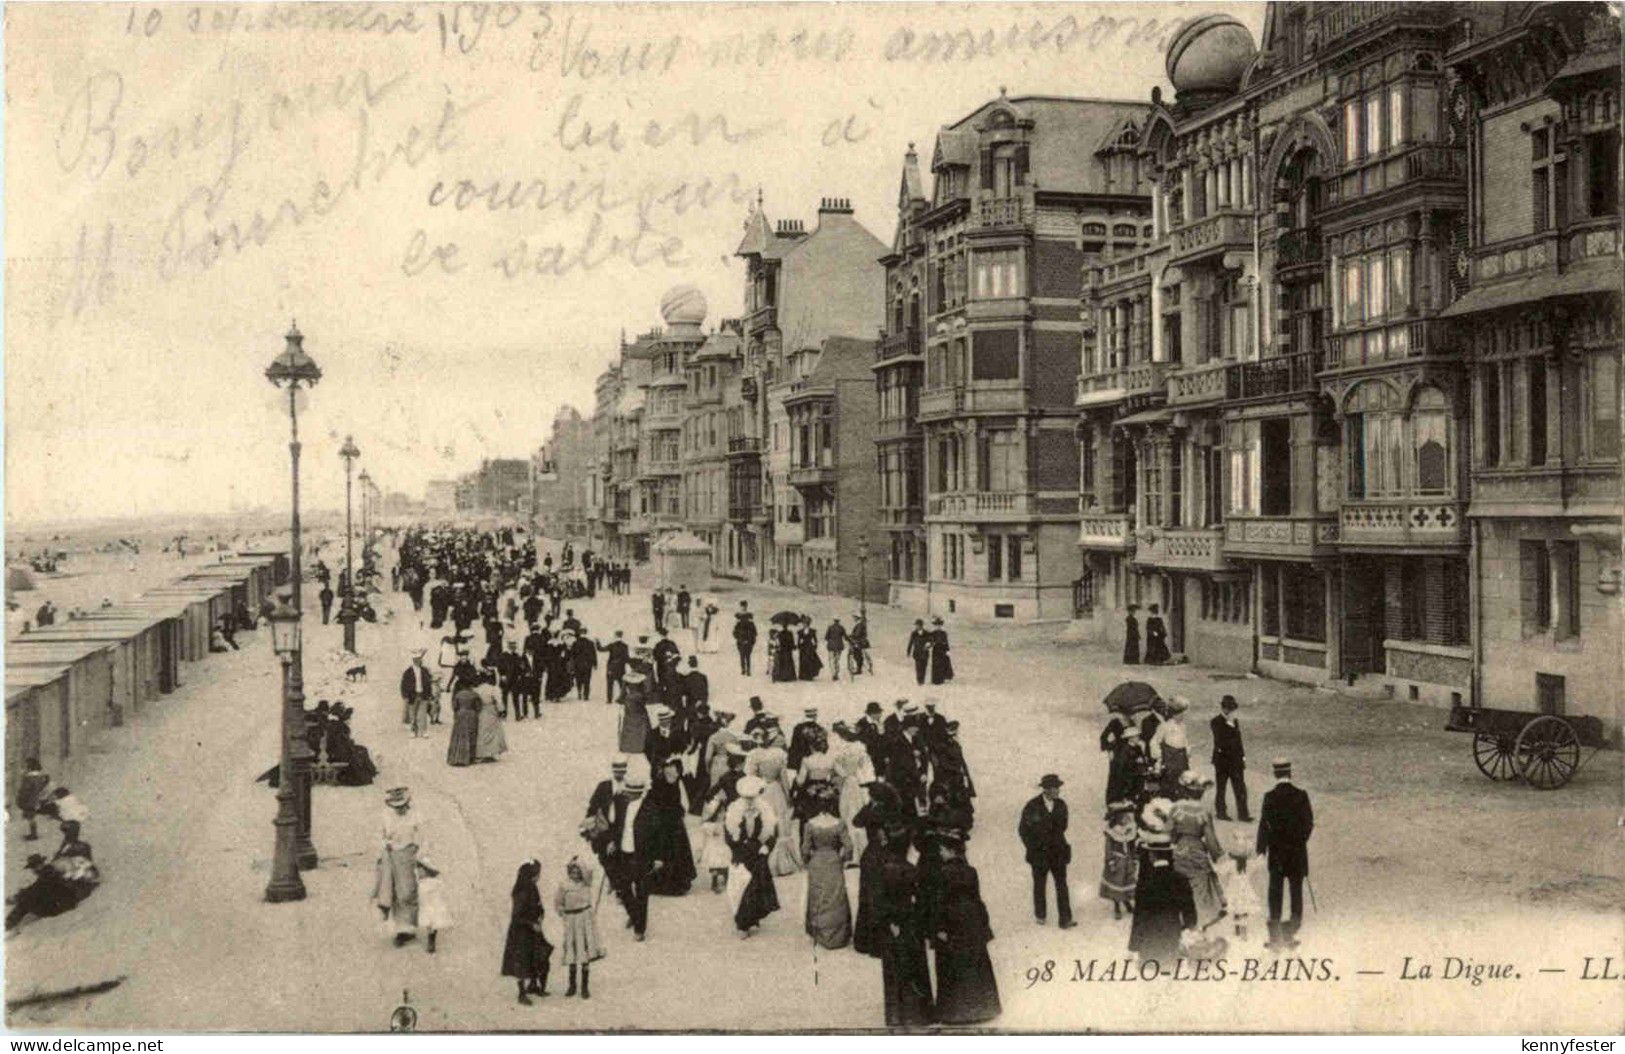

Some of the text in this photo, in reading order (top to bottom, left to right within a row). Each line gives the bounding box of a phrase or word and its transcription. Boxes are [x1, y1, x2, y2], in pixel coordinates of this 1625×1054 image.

[1025, 960, 1056, 987] 98
[1070, 957, 1341, 983] MALO-LES-BAINS.
[1400, 956, 1432, 980] La
[1442, 957, 1522, 985] Digue.
